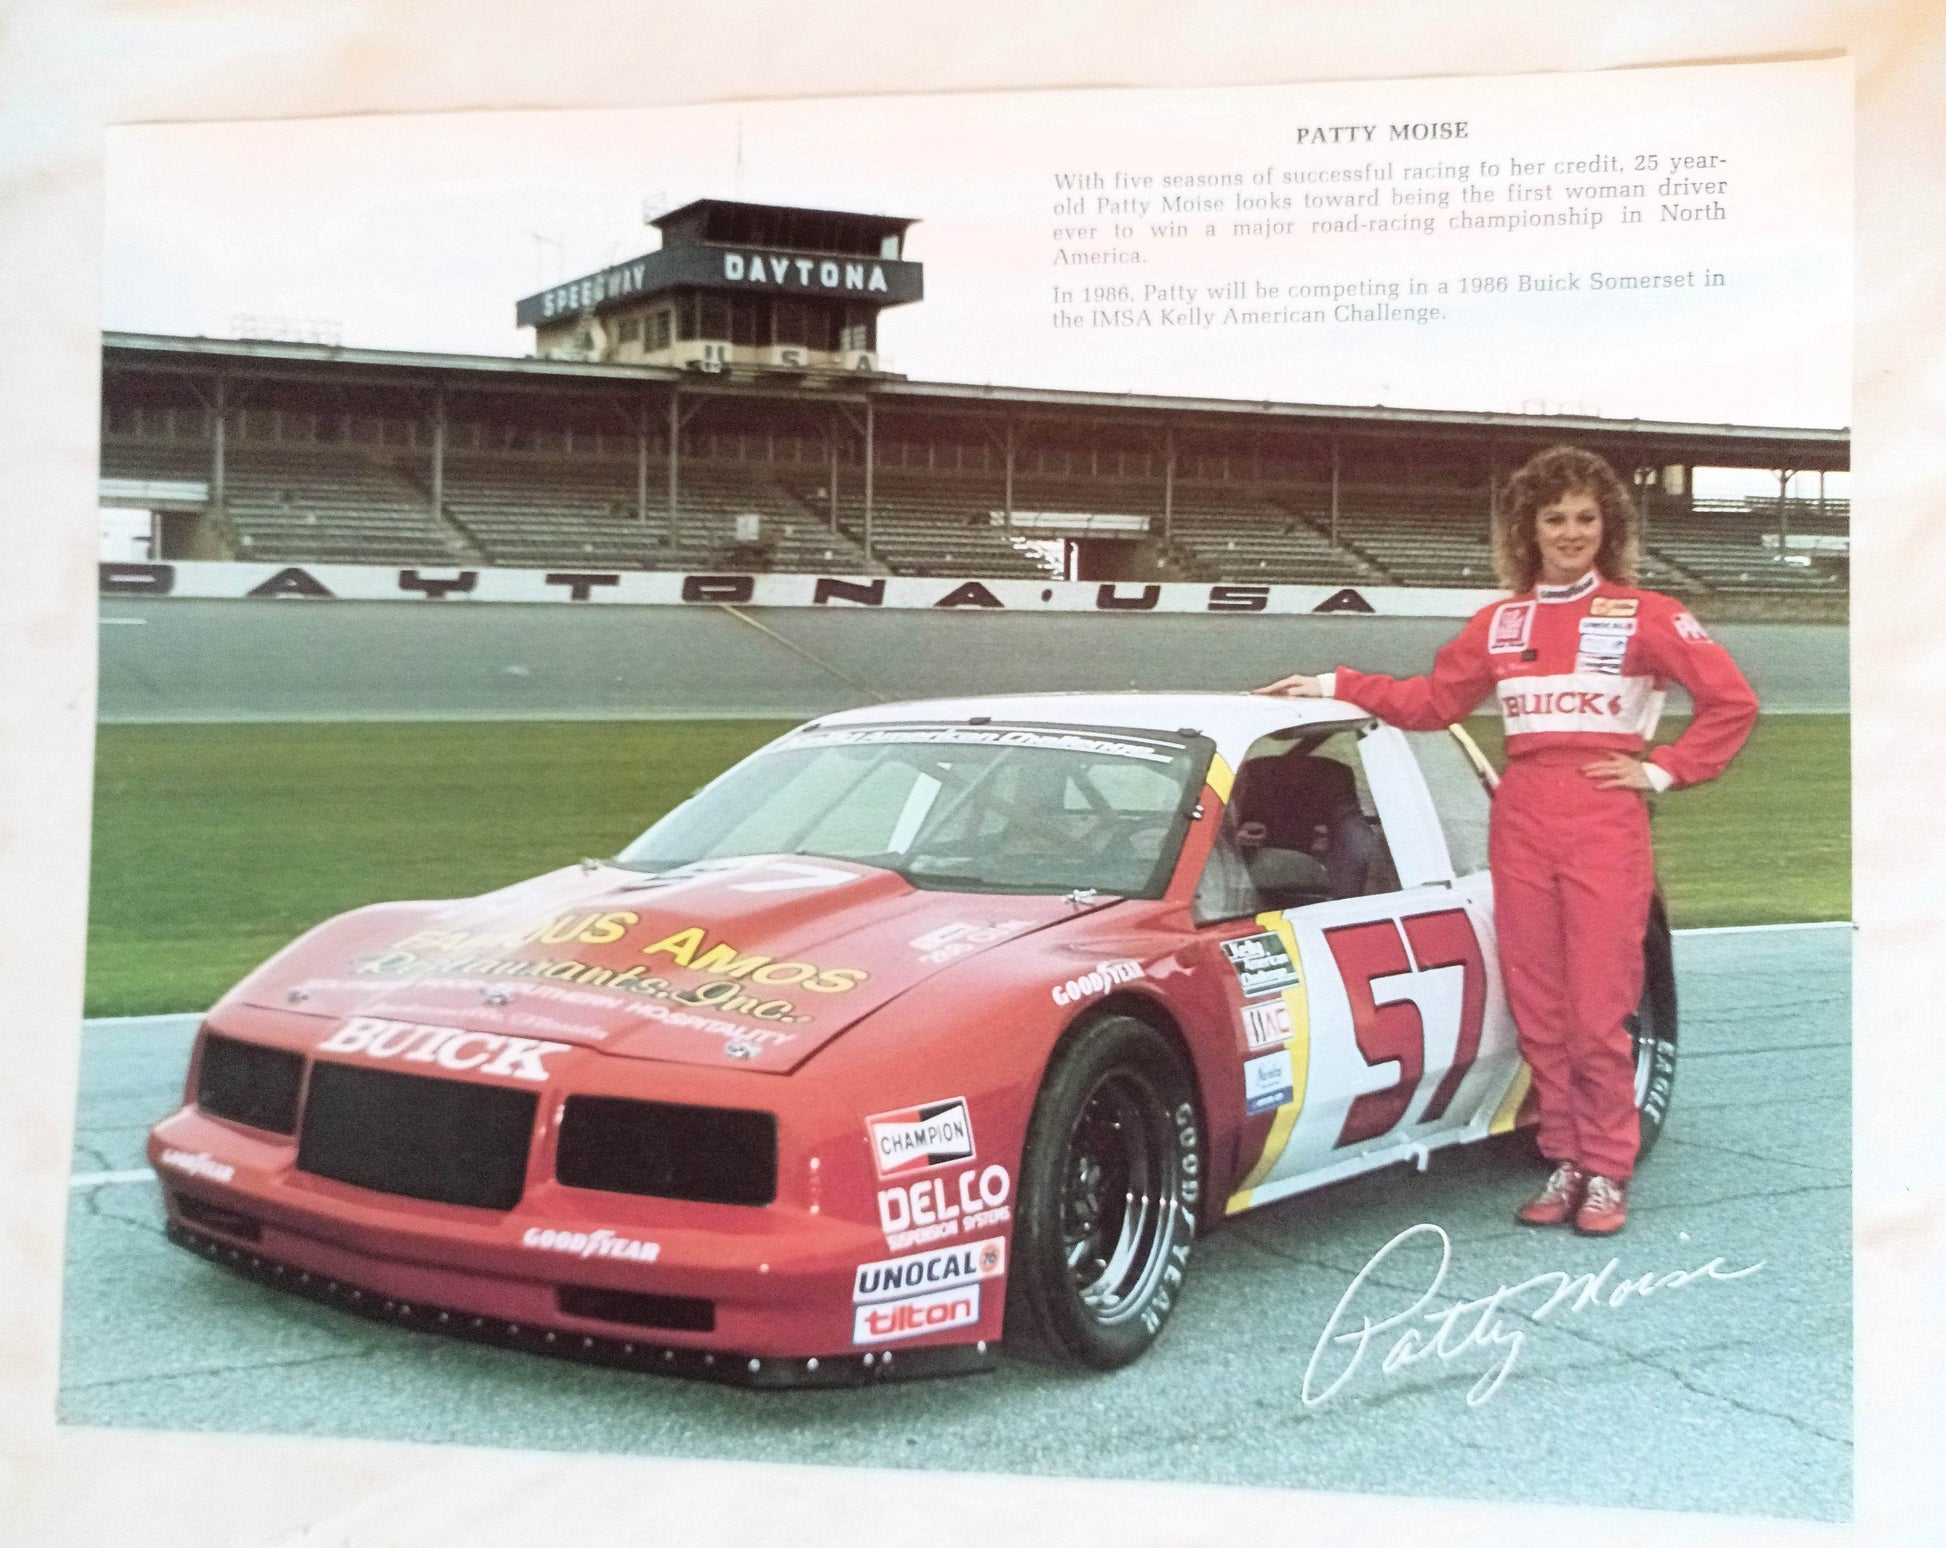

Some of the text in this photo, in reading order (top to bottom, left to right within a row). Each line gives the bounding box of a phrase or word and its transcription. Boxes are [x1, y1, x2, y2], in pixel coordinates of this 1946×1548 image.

[1297, 122, 1468, 144] PATTY MOISE
[1054, 172, 1104, 190] With
[1115, 172, 1153, 189] five
[1162, 173, 1243, 188] seasons
[1253, 168, 1273, 186] of
[1283, 164, 1392, 184] successful
[1404, 161, 1469, 182] racing
[1511, 158, 1544, 176] her
[1634, 154, 1658, 171] 25
[1670, 154, 1726, 172] year-
[1054, 178, 1727, 218] old Patty Moise looks toward being the first woman driver
[1053, 201, 1726, 242] ever to win a major road-racing championship in North
[724, 252, 888, 293] DAYTONA
[1054, 248, 1146, 265] America.
[542, 261, 646, 318] SPEEDWAY
[1053, 285, 1072, 304] In
[1144, 284, 1197, 304] Patty
[1208, 281, 1245, 299] will
[1257, 280, 1279, 299] be
[1288, 277, 1399, 300] competing
[1409, 278, 1427, 295] in
[1438, 279, 1448, 294] a
[1459, 275, 1507, 294] 1986
[1519, 272, 1579, 291] Buick
[1590, 271, 1693, 290] Somerset
[1704, 269, 1725, 287] in
[1053, 301, 1446, 328] the IMSA Kelly American Challenge.
[1502, 692, 1604, 717] BUICK
[643, 926, 869, 993] AMOS
[318, 1014, 574, 1080] BUICK
[1322, 907, 1488, 1151] 57
[880, 1120, 964, 1156] CHAMPION
[878, 1164, 1011, 1235] DELCO
[523, 1226, 660, 1262] GOODYEAR
[858, 1251, 977, 1294] UNOCAL
[864, 1298, 972, 1335] tilton
[1302, 1223, 1526, 1405] Patty
